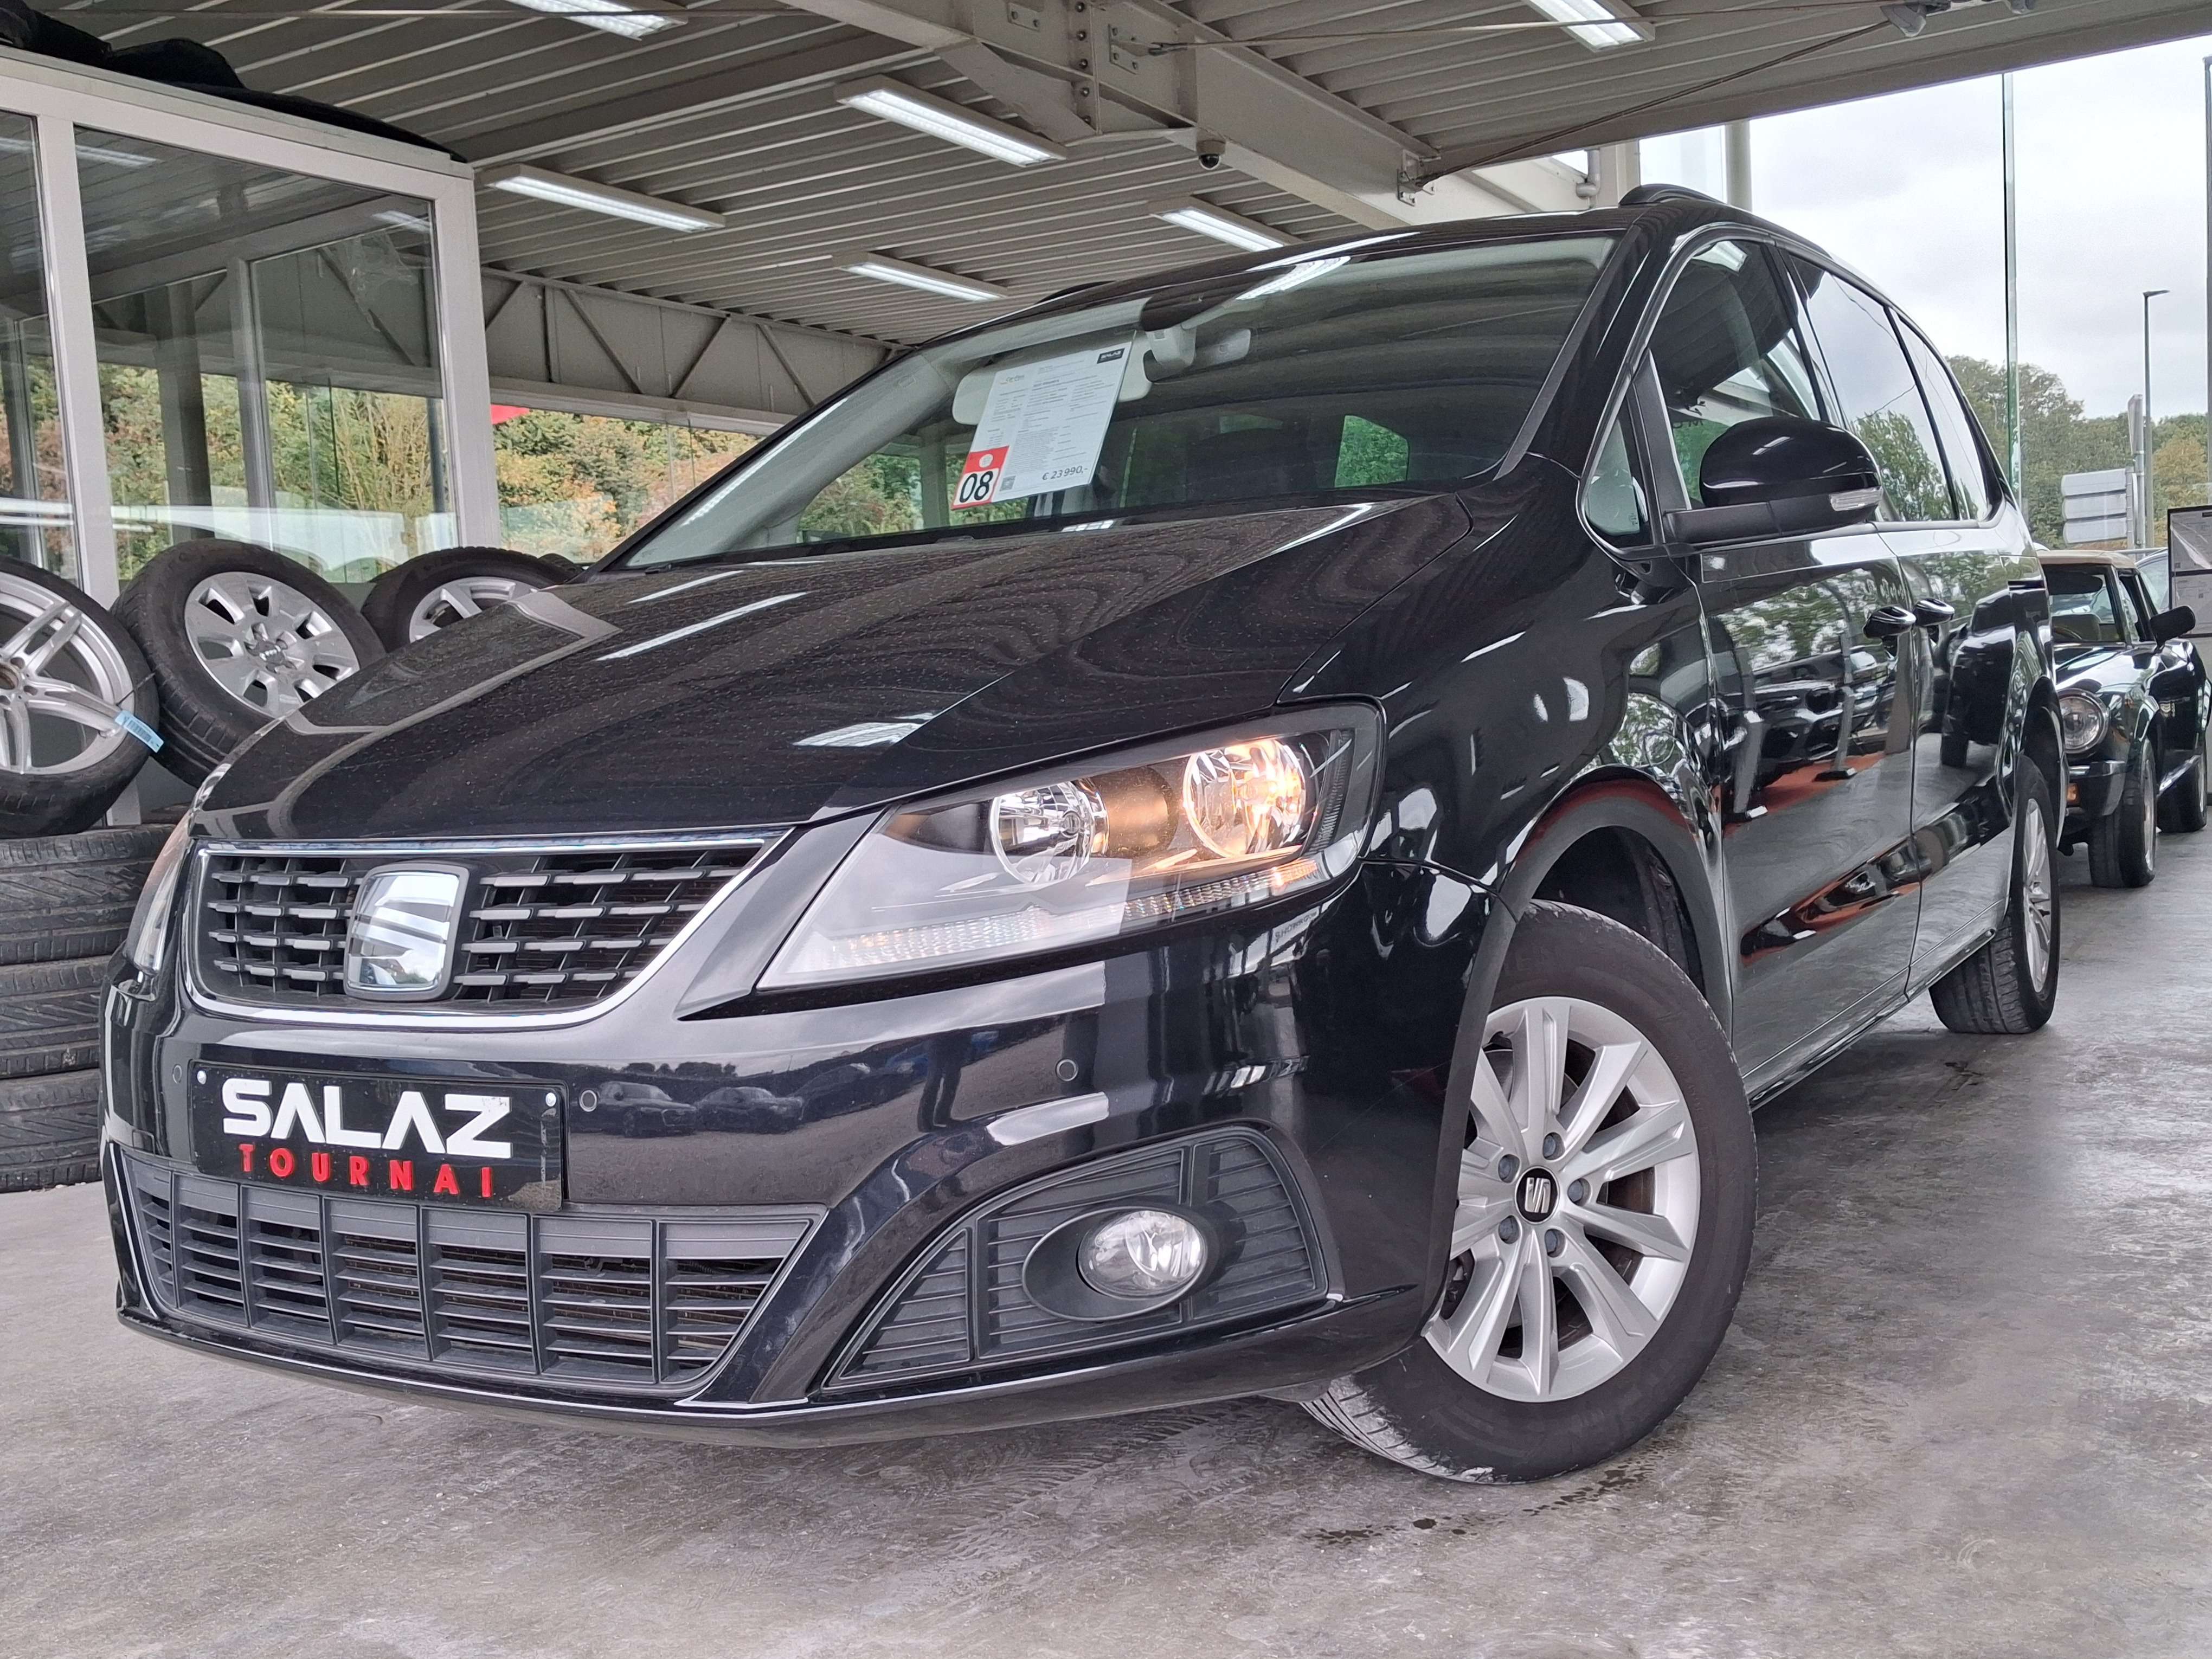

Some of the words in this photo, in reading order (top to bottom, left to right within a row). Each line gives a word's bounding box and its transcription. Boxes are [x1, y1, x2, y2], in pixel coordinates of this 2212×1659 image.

[959, 471, 993, 503] 08
[222, 1077, 513, 1159] SALAZ
[239, 1143, 492, 1198] TOURNAI
